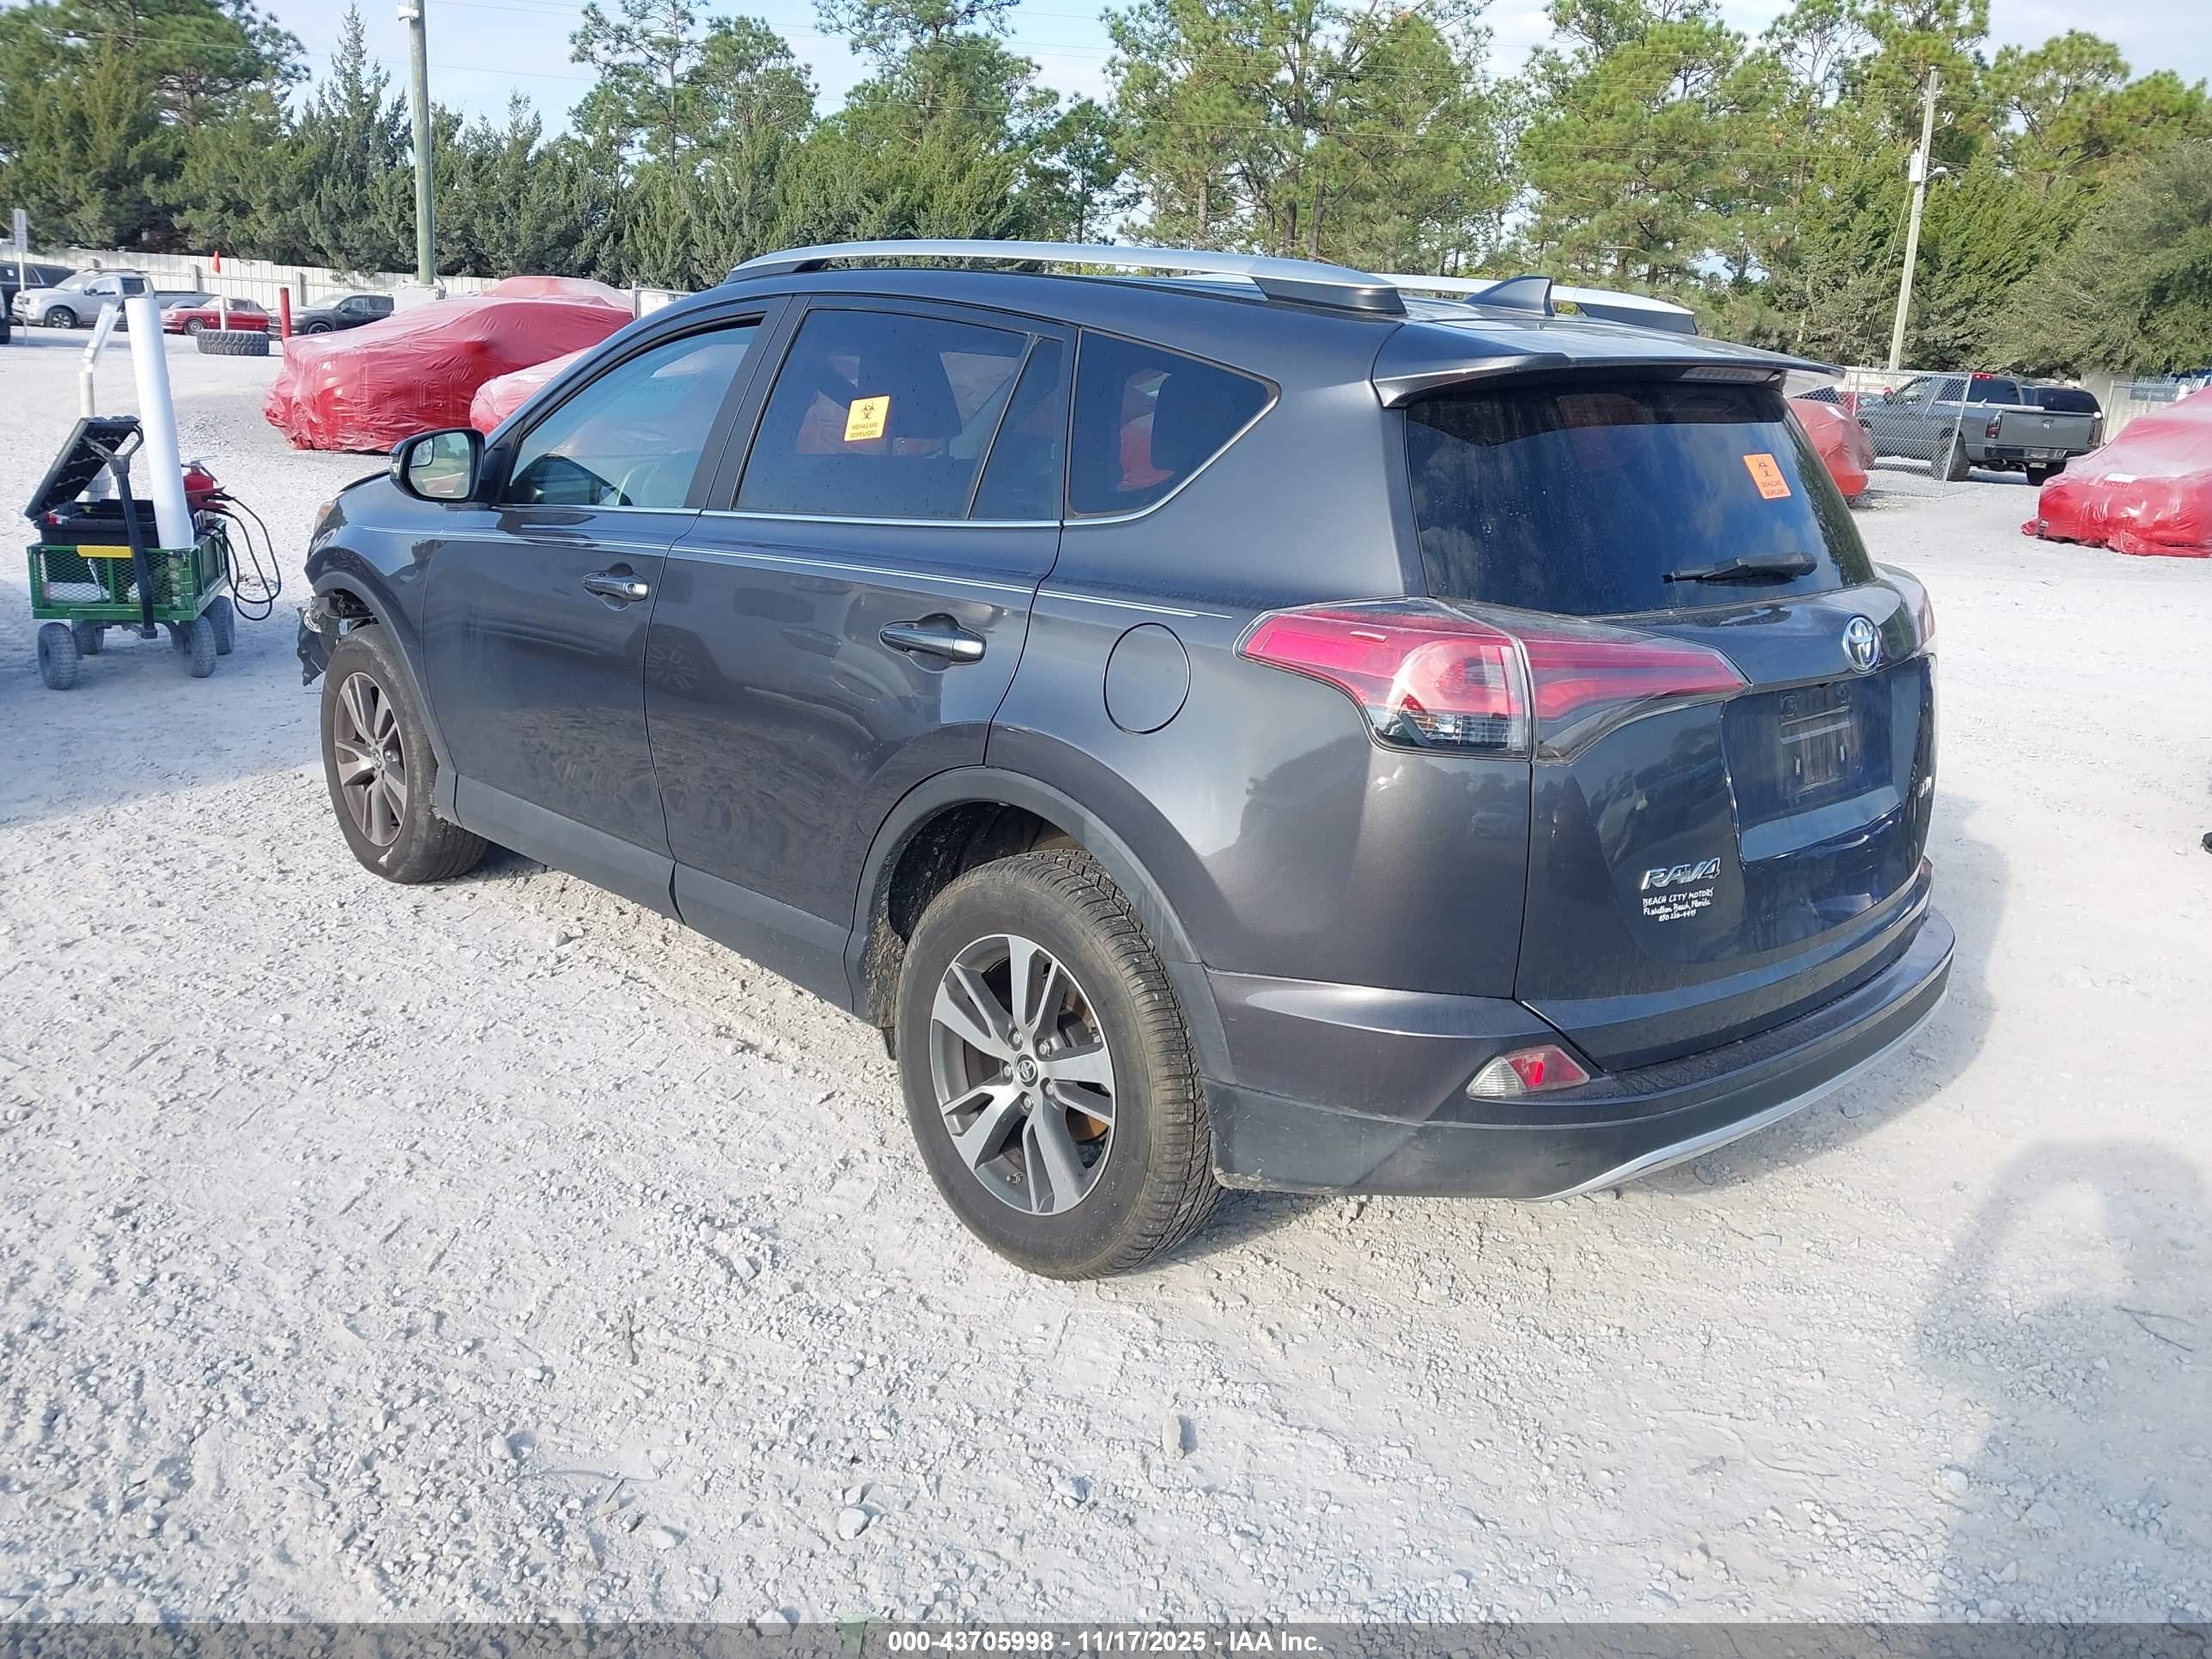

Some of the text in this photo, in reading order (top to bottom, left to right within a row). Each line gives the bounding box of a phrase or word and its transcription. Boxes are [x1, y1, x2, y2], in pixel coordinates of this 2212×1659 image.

[1641, 857, 1721, 890] RAV4
[1643, 886, 1715, 908] BEACH CITY MOTORS
[1691, 897, 1711, 908] Florida
